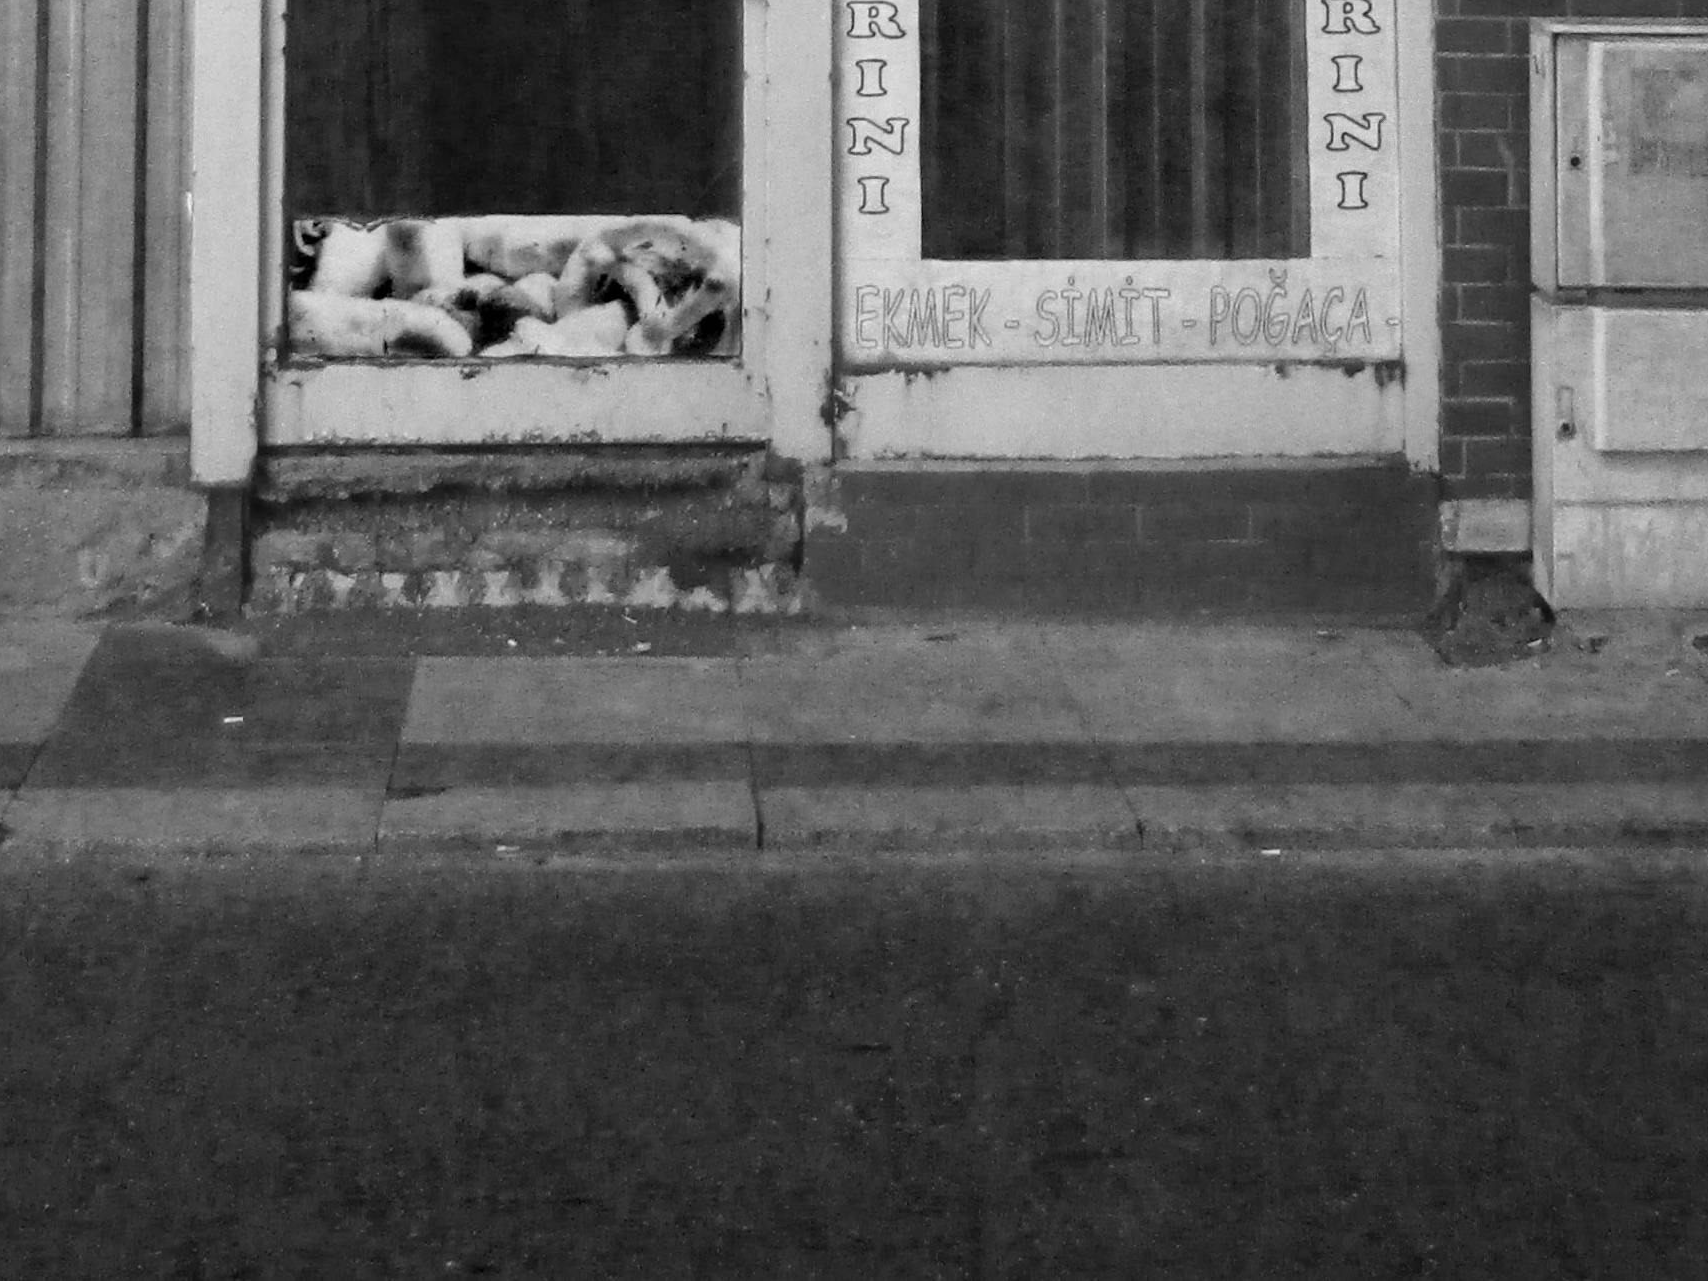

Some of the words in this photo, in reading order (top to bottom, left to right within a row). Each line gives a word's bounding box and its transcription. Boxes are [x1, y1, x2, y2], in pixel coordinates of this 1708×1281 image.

[854, 284, 993, 351] EKMEK
[1035, 275, 1171, 349] SİMİT
[1208, 267, 1372, 355] POĞAÇA
